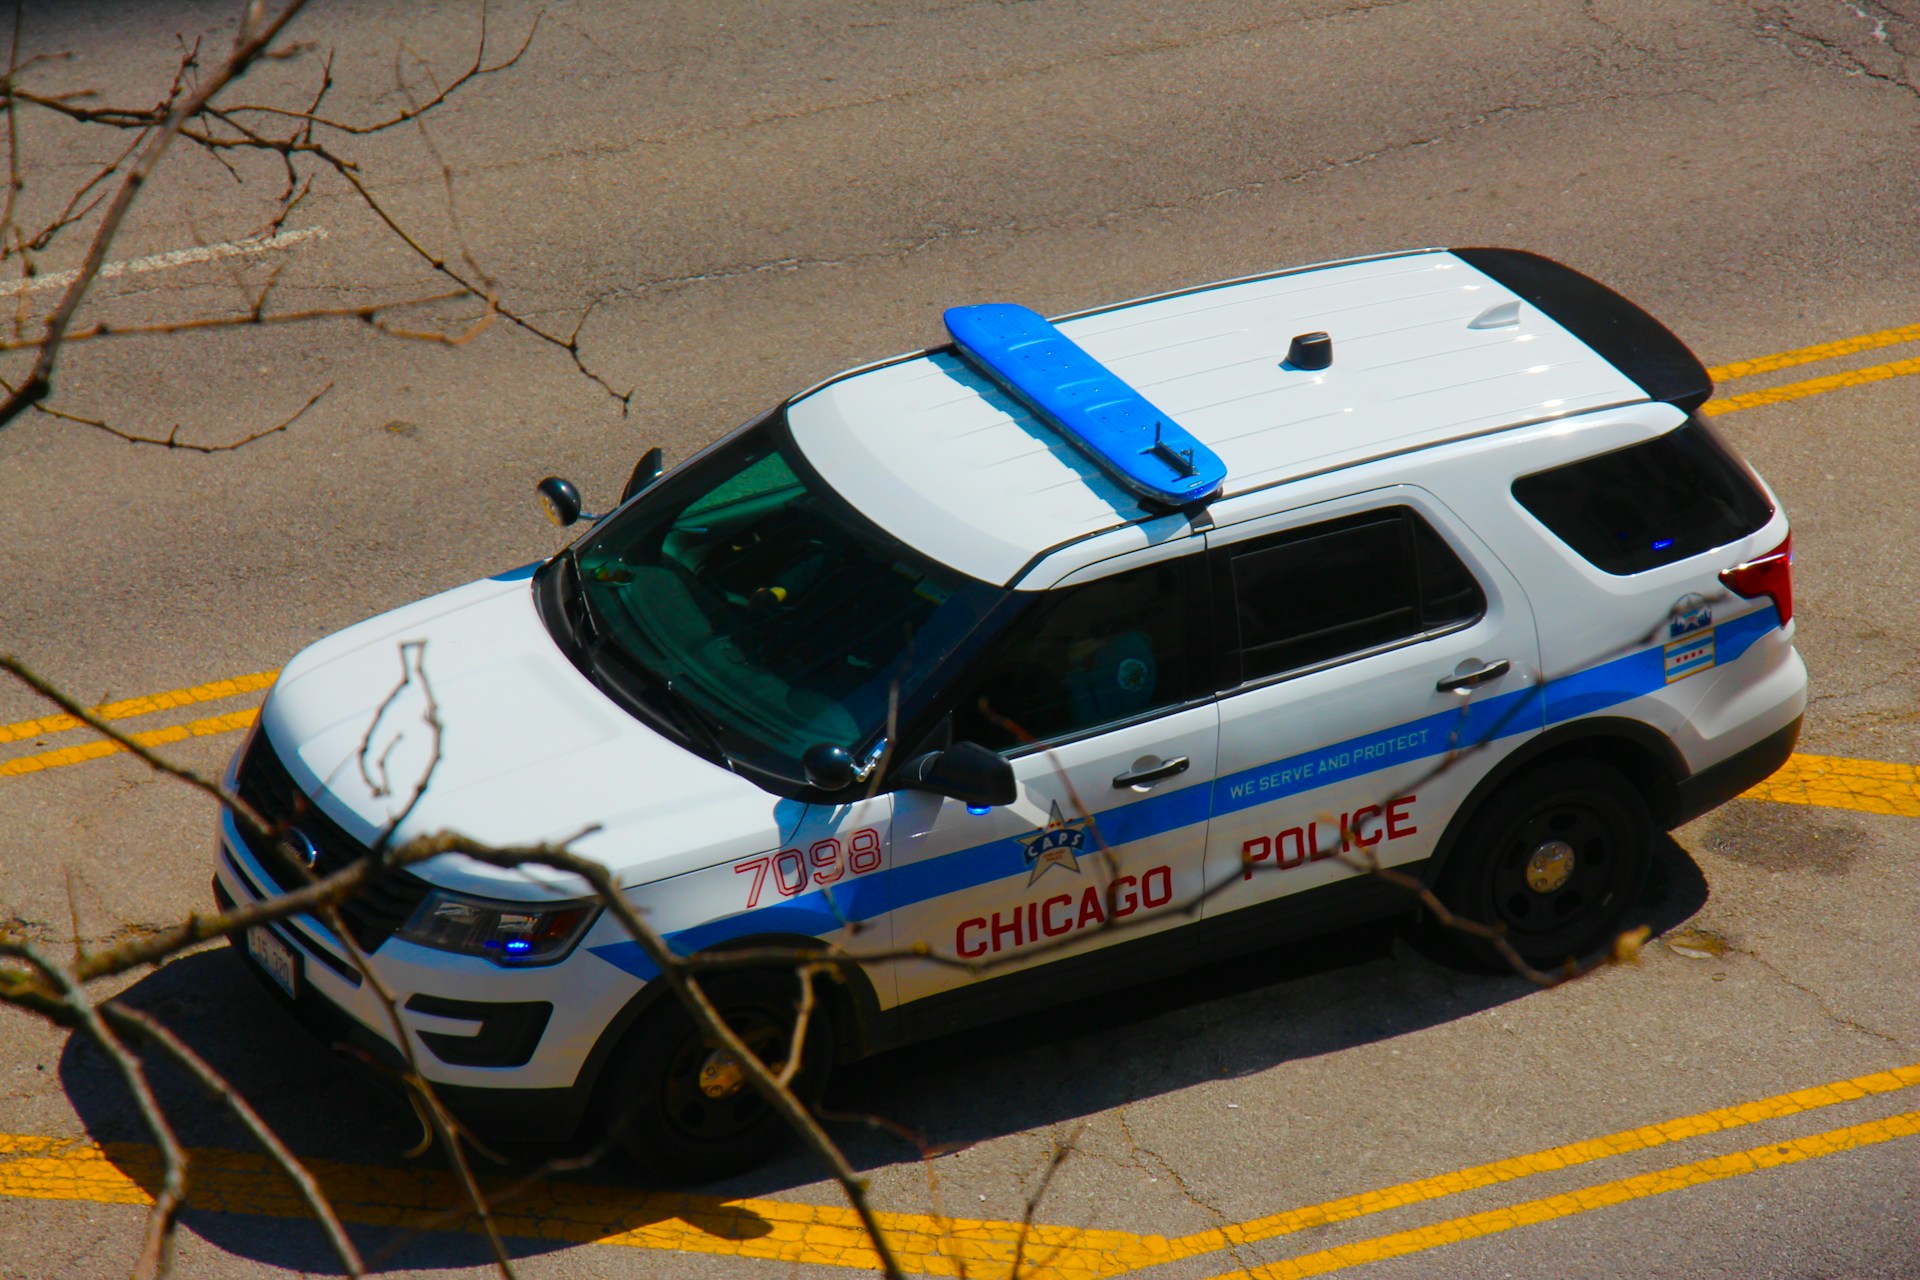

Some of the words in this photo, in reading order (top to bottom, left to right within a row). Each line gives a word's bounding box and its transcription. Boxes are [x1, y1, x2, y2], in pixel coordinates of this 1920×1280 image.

[1230, 780, 1255, 799] WE
[1259, 763, 1314, 791] SERVE
[1318, 752, 1350, 774] AND
[1353, 729, 1429, 763] PROTECT
[734, 828, 882, 909] 7098
[1027, 832, 1082, 858] CAPS
[1242, 795, 1417, 881] POLICE
[956, 865, 1173, 960] CHICAGO
